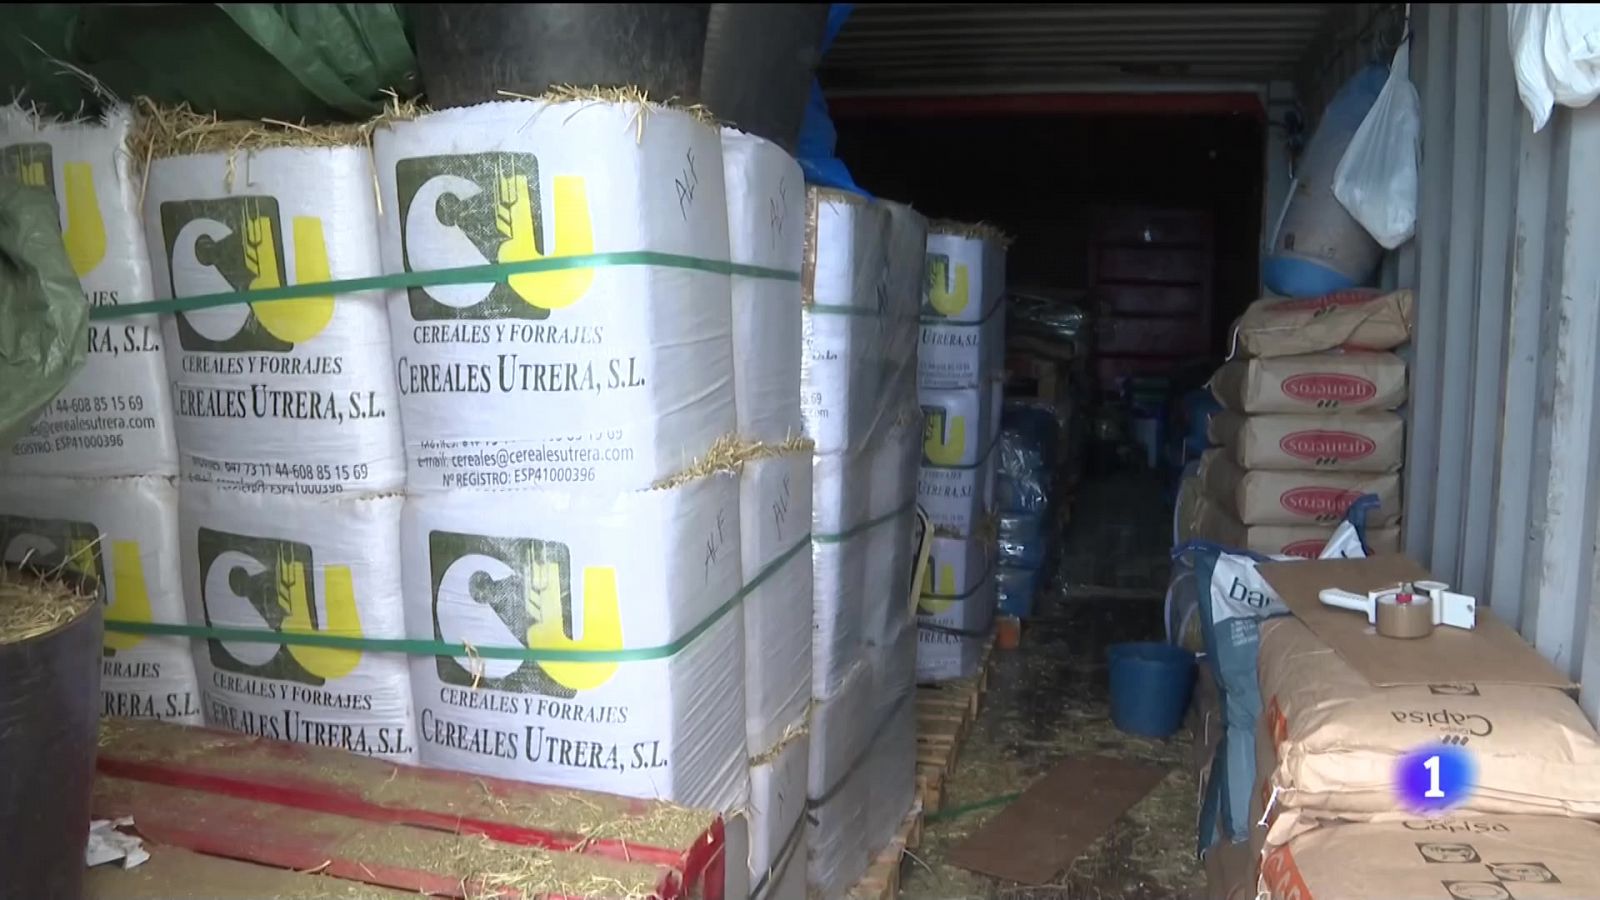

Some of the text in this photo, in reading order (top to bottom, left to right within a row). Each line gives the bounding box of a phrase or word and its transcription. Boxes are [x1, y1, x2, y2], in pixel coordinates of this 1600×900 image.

[123, 325, 160, 353] S.L.
[413, 323, 605, 345] CEREALES Y FORRAJES
[182, 355, 344, 375] CEREALES Y FORRAJES
[397, 353, 646, 397] CEREALES UTRERA, S.L.
[94, 396, 109, 411] 85
[112, 396, 126, 411] 15
[128, 395, 144, 411] 69
[250, 384, 344, 424] UTRERA,
[349, 390, 386, 420] S.L.
[451, 445, 635, 469] cereales@cerealesutrera.com
[275, 463, 313, 481] 44-608
[316, 464, 331, 481] 85
[335, 464, 350, 481] 15
[353, 463, 369, 480] 69
[456, 472, 512, 488] REGISTRO:
[514, 467, 596, 484] ESP41000396
[103, 662, 161, 679] RRAJES
[212, 671, 373, 711] CEREALES Y FORRAJES
[440, 686, 629, 724] CEREALES Y FORRAJES
[101, 690, 202, 721] RERA, S.L.
[283, 709, 373, 757] UTRERA,
[377, 727, 414, 754] S.L.
[1390, 709, 1493, 737] Capisa
[420, 708, 669, 775] CEREALES UTRERA, S.L.
